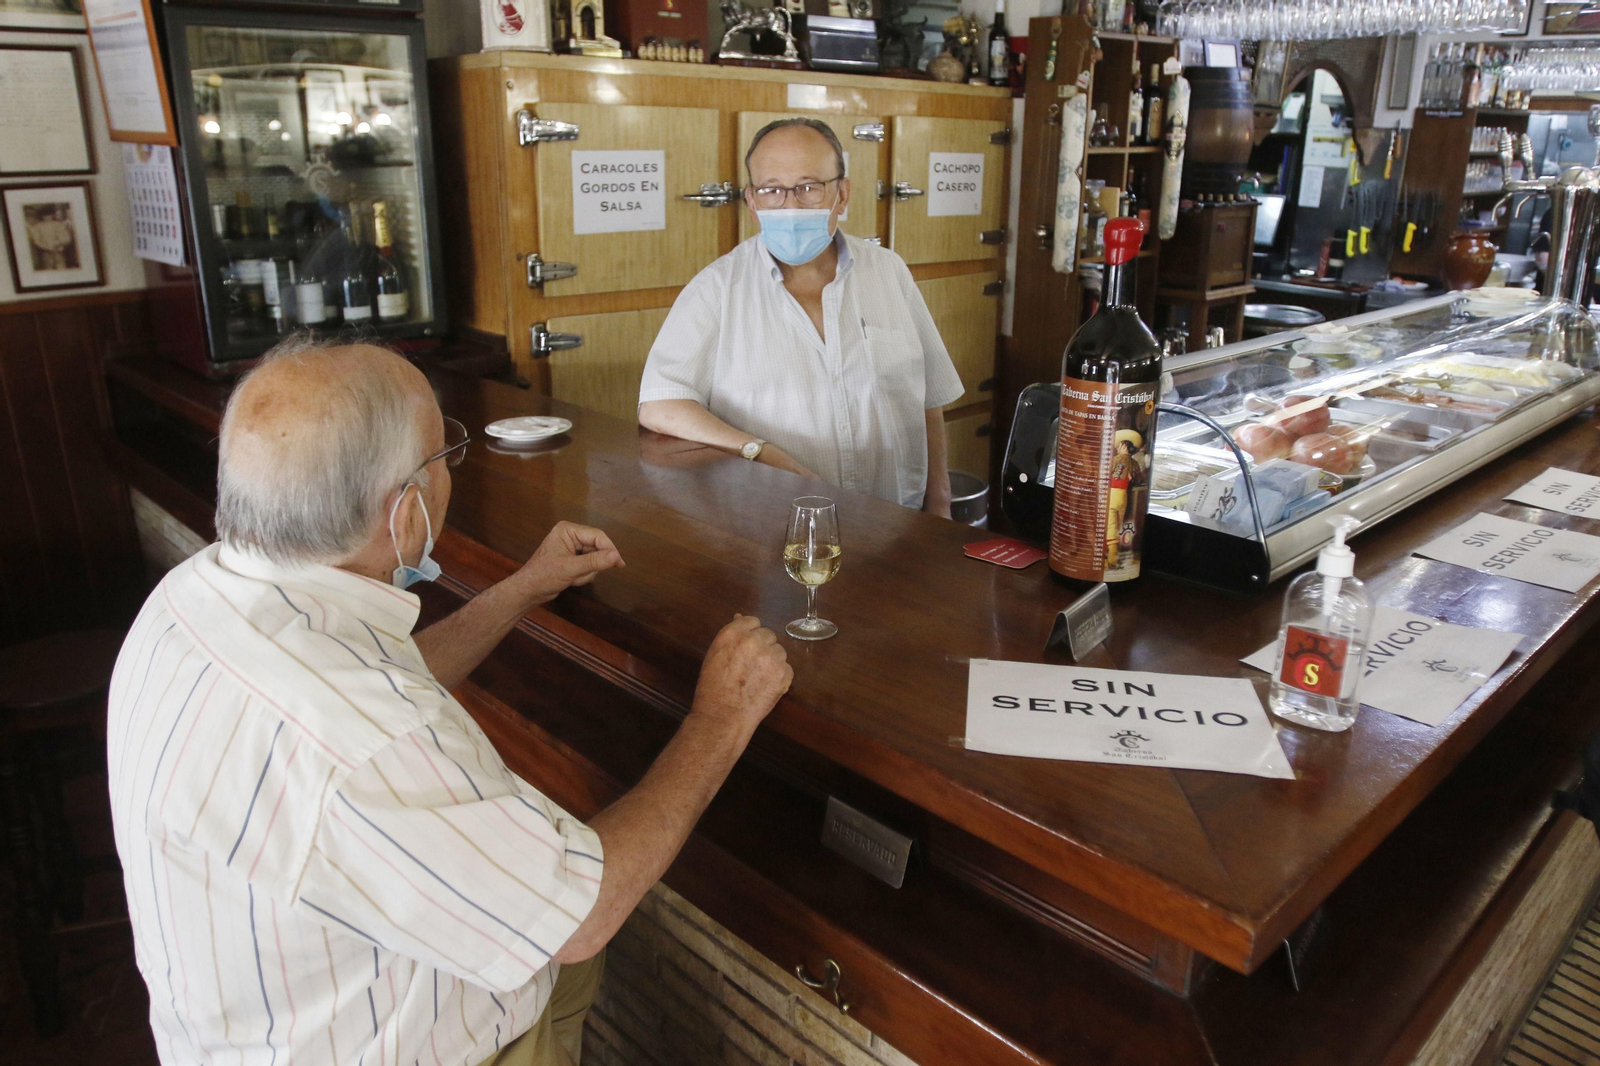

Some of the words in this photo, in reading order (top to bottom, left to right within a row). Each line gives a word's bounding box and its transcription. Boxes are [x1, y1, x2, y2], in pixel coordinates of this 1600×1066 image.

[580, 163, 658, 174] CARACOLES
[934, 163, 981, 173] CACHOPO
[580, 182, 636, 193] GORDOS
[641, 180, 659, 192] EN
[937, 181, 976, 192] CASERO
[600, 201, 642, 212] SALSA
[1062, 384, 1089, 401] Taberna
[1091, 391, 1112, 403] San
[1114, 391, 1155, 404] Cristóbal
[1542, 482, 1573, 496] SIN
[1462, 530, 1500, 548] SIN
[1482, 529, 1555, 570] SERVICIO
[1364, 620, 1433, 677] RVICIO
[1071, 679, 1157, 697] SIN
[992, 695, 1249, 727] SERVICIO
[1114, 747, 1153, 755] Taberna
